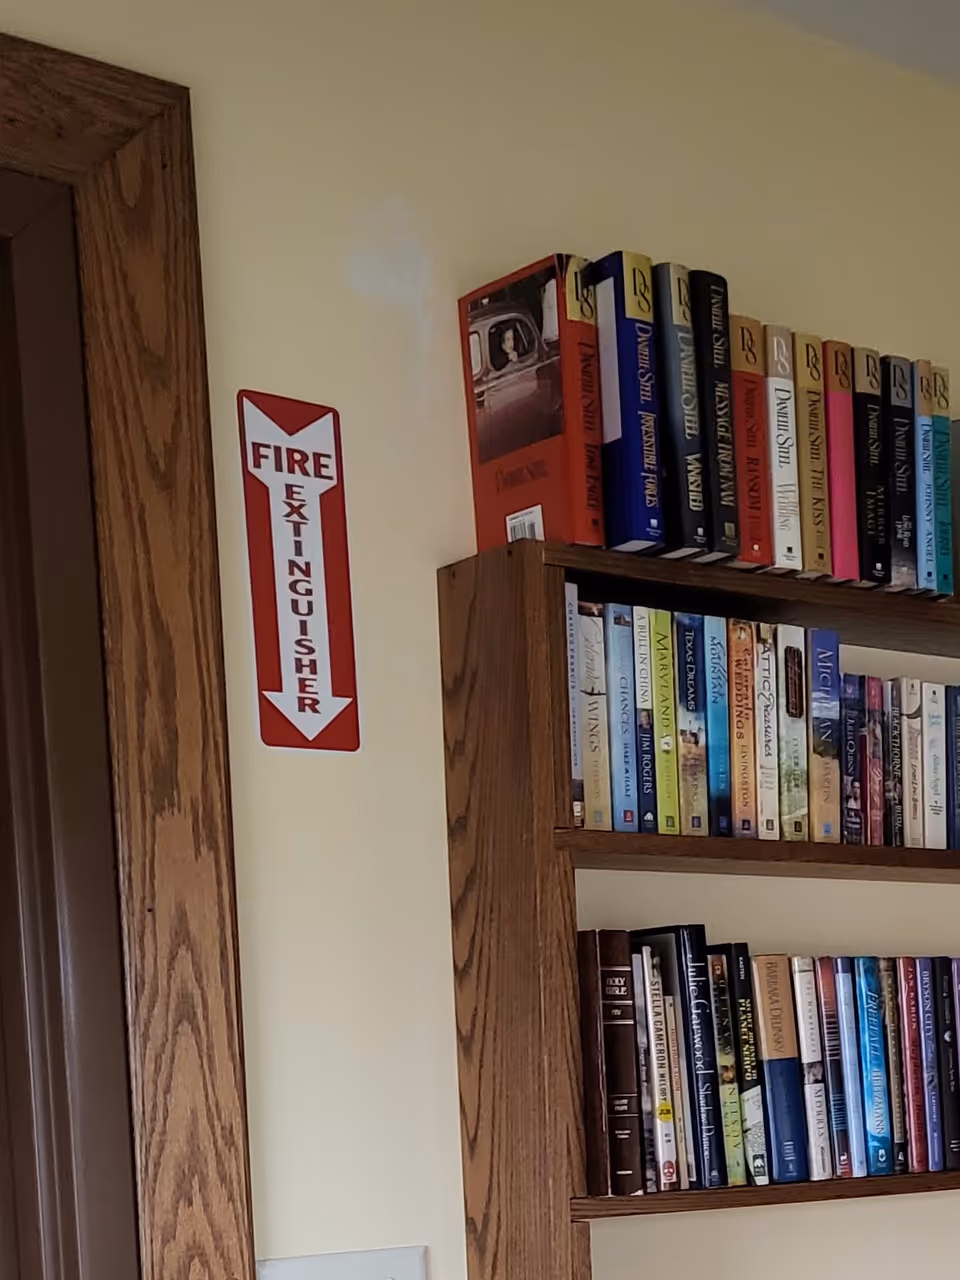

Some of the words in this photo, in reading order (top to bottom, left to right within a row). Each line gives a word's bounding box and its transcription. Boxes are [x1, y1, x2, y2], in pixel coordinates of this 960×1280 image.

[709, 284, 725, 331] DANIELLE
[634, 323, 654, 370] DANIELLE
[677, 331, 696, 393] DANIELLE
[712, 333, 728, 368] STEEL
[637, 370, 655, 404] STEEL
[681, 393, 699, 439] STEEL
[715, 381, 731, 439] MESSAGE
[775, 387, 791, 433] DANIELLE
[807, 389, 823, 430] DANIELLE
[637, 411, 656, 471] IRRESISTIBLE
[777, 432, 794, 468] STEEL
[809, 431, 825, 463] STEEL
[868, 432, 882, 466] STEEL
[920, 423, 932, 452] DANIELLE
[252, 442, 334, 480] FIRE
[717, 442, 734, 476] FROM
[922, 453, 933, 475] STEEL
[641, 472, 658, 507] FORCES
[685, 453, 704, 511] VANISHED
[720, 479, 736, 506] NAM
[811, 496, 827, 526] KISS
[924, 483, 933, 525] JOHNNY
[925, 529, 935, 565] ANGEL
[281, 483, 321, 714] EXTINGUISHER
[637, 614, 646, 622] A
[638, 623, 647, 652] BULL
[684, 630, 695, 662] TEXAS
[638, 654, 648, 666] IN
[655, 631, 672, 728] MARYLAND
[708, 636, 719, 704] MOUNTAIN
[760, 641, 771, 693] ATTIC
[620, 676, 630, 734] CHANGES
[640, 667, 649, 704] CHINA
[686, 664, 697, 710] DREAMS
[734, 658, 745, 740] WEDDINGS
[589, 701, 601, 752] WINGS
[641, 733, 651, 751] JIM
[759, 692, 777, 758] Treasures
[892, 707, 900, 778] BLACKTHORNE
[642, 754, 653, 794] ROGERS
[741, 744, 751, 807] LIVINGSTON
[846, 740, 858, 774] QUINN
[686, 955, 705, 996] Julie
[765, 961, 779, 1005] BARBARA
[923, 971, 932, 1011] BRYSON
[650, 980, 665, 1018] STELLA
[738, 999, 748, 1038] PLANET
[909, 992, 917, 1030] KARON
[653, 1020, 666, 1069] CAMERON
[691, 999, 714, 1074] Garwood
[770, 1007, 784, 1052] DELINSKY
[867, 992, 880, 1057] FREEFALL
[924, 1014, 934, 1037] CITY
[741, 1041, 752, 1080] SERPO
[657, 1073, 668, 1102] MELODY
[699, 1083, 713, 1122] Shadow
[872, 1068, 885, 1134] HEITZMANN
[727, 1087, 741, 1149] AUSTIN
[813, 1088, 825, 1138] MORRIS
[702, 1125, 715, 1160] Dance
